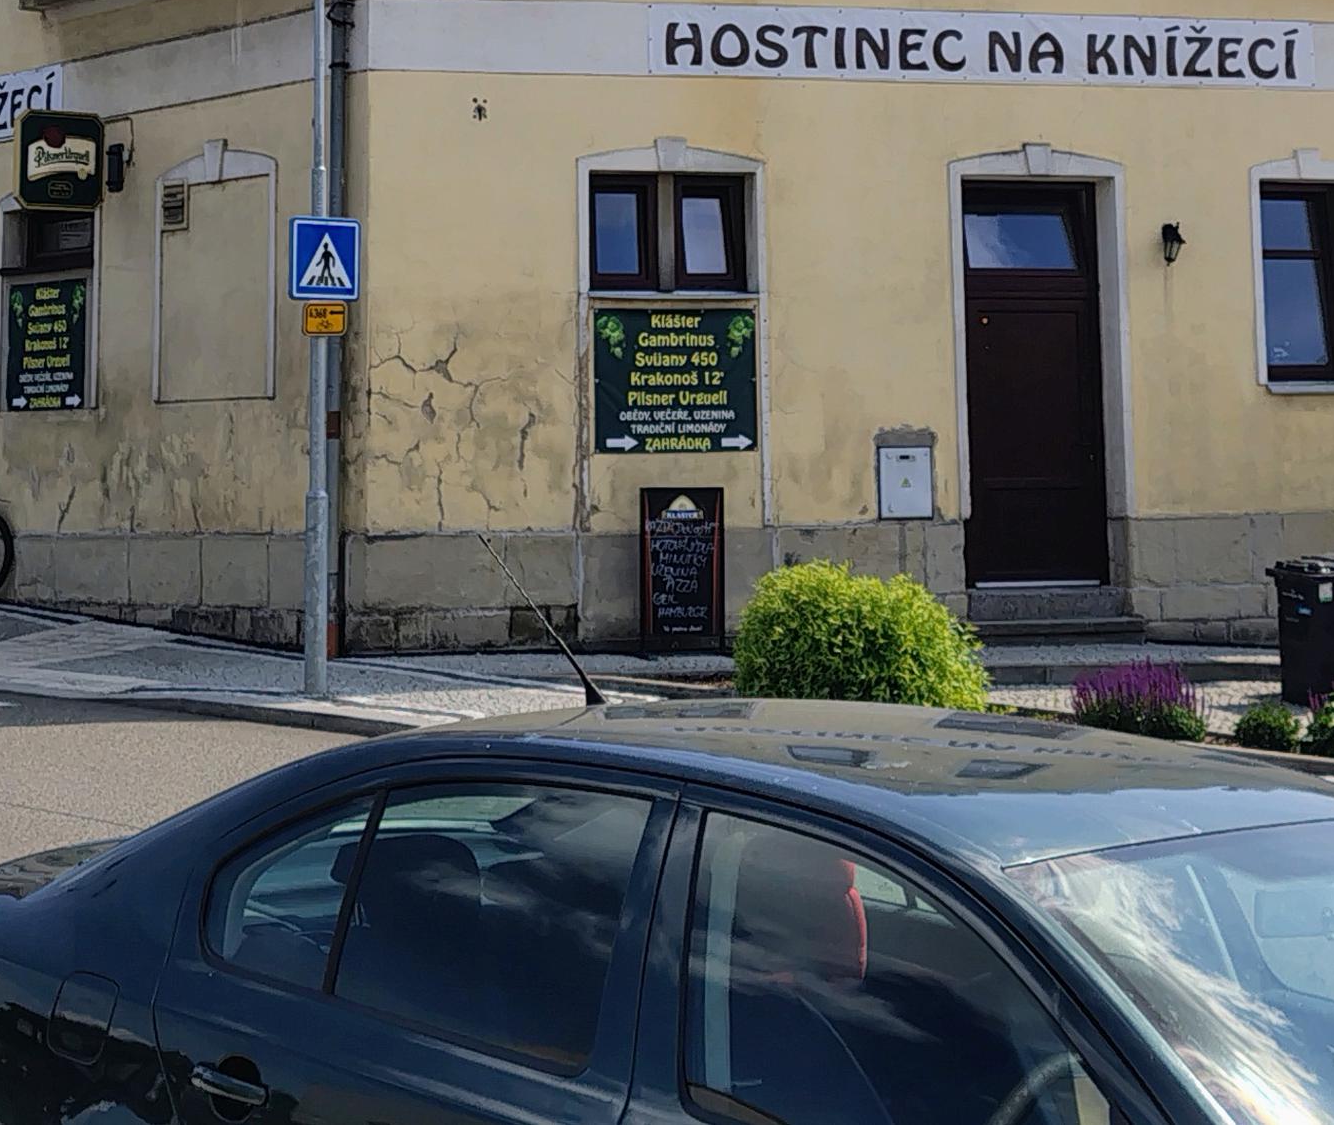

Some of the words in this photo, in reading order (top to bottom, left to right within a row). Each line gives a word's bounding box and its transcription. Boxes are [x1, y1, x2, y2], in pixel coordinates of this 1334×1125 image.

[666, 22, 967, 73] HOSTINEC
[988, 30, 1065, 75] NA
[1086, 26, 1300, 81] KNÍŽECÍ
[651, 313, 701, 328] Klášter
[638, 332, 715, 347] Gambrinus
[635, 351, 688, 367] Svijany
[691, 352, 718, 366] 450
[630, 371, 698, 386] Krakonoš
[628, 391, 676, 406] Pilsner
[693, 409, 735, 421] UZENINA
[630, 422, 676, 434] TRADIČNÍ
[645, 435, 711, 451] ZAHRÁDKA
